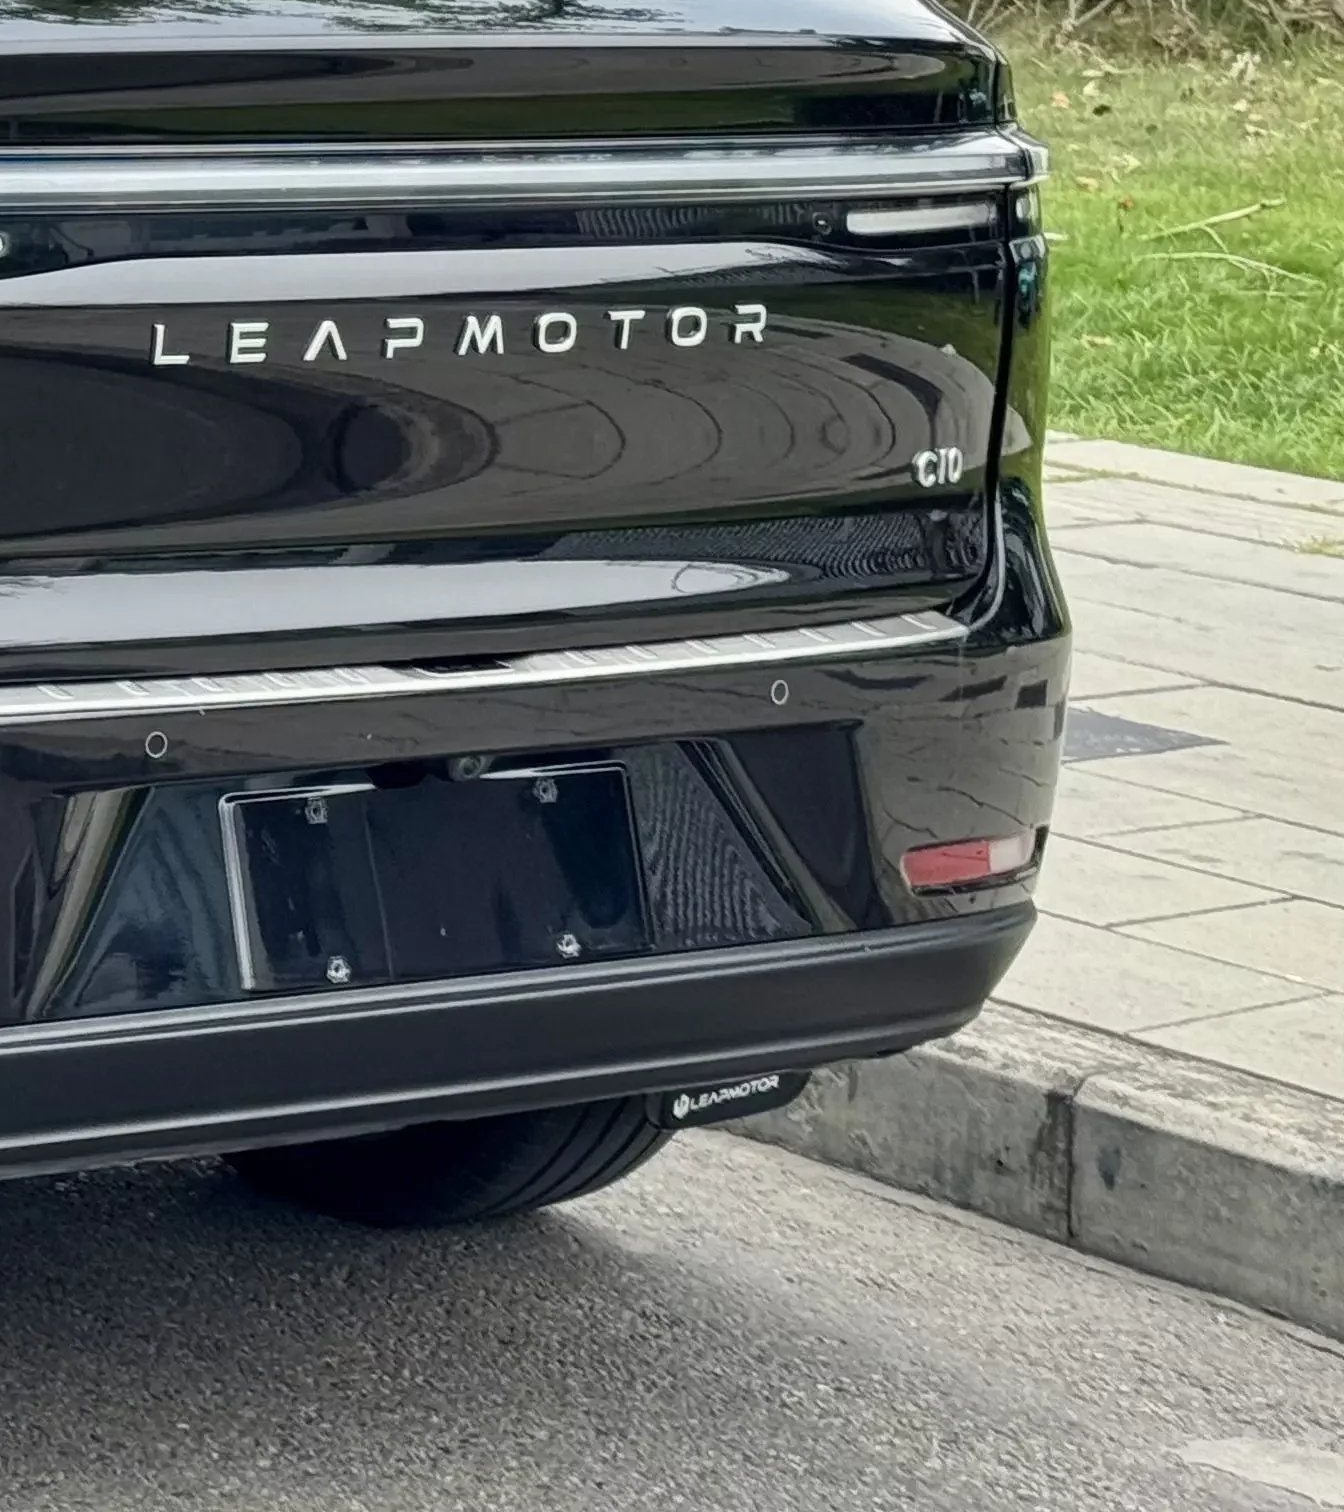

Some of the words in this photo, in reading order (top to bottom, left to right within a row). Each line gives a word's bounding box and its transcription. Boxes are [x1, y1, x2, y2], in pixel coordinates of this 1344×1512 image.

[152, 303, 768, 365] LEAPMOTOR
[916, 447, 963, 487] C10
[689, 1074, 780, 1110] LEAPMOTOR
